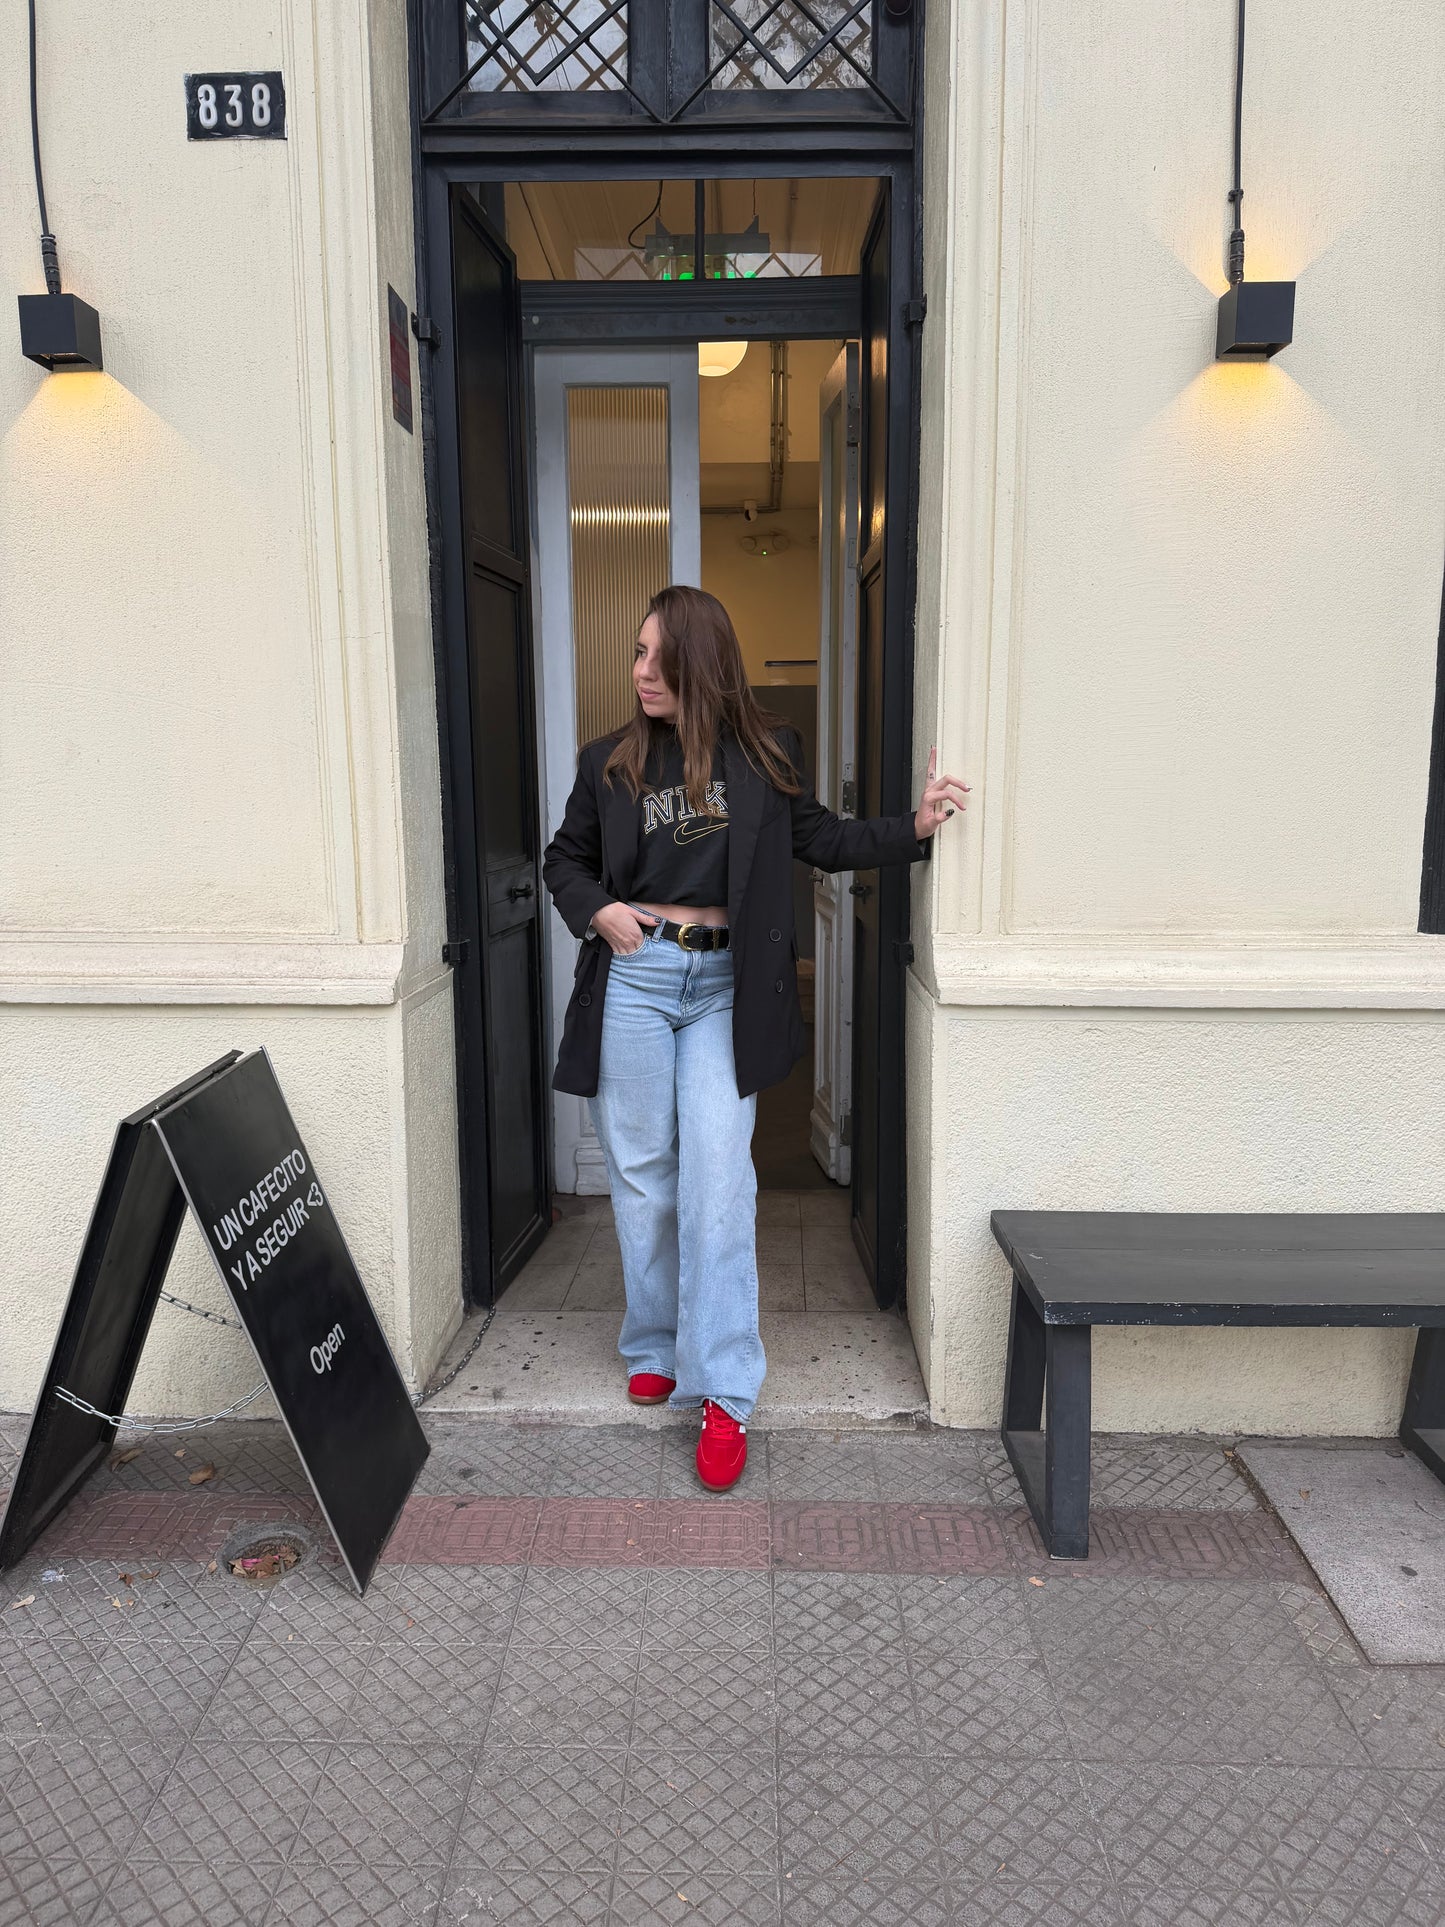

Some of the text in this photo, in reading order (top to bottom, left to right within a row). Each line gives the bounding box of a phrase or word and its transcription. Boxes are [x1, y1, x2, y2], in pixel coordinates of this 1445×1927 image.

[197, 82, 271, 129] 838
[642, 780, 729, 835] NIK
[213, 1149, 306, 1251] UN CAFECITO
[230, 1260, 248, 1291] Y
[245, 1251, 263, 1282] A
[256, 1197, 310, 1266] SEGUIR
[310, 1323, 346, 1375] Open
